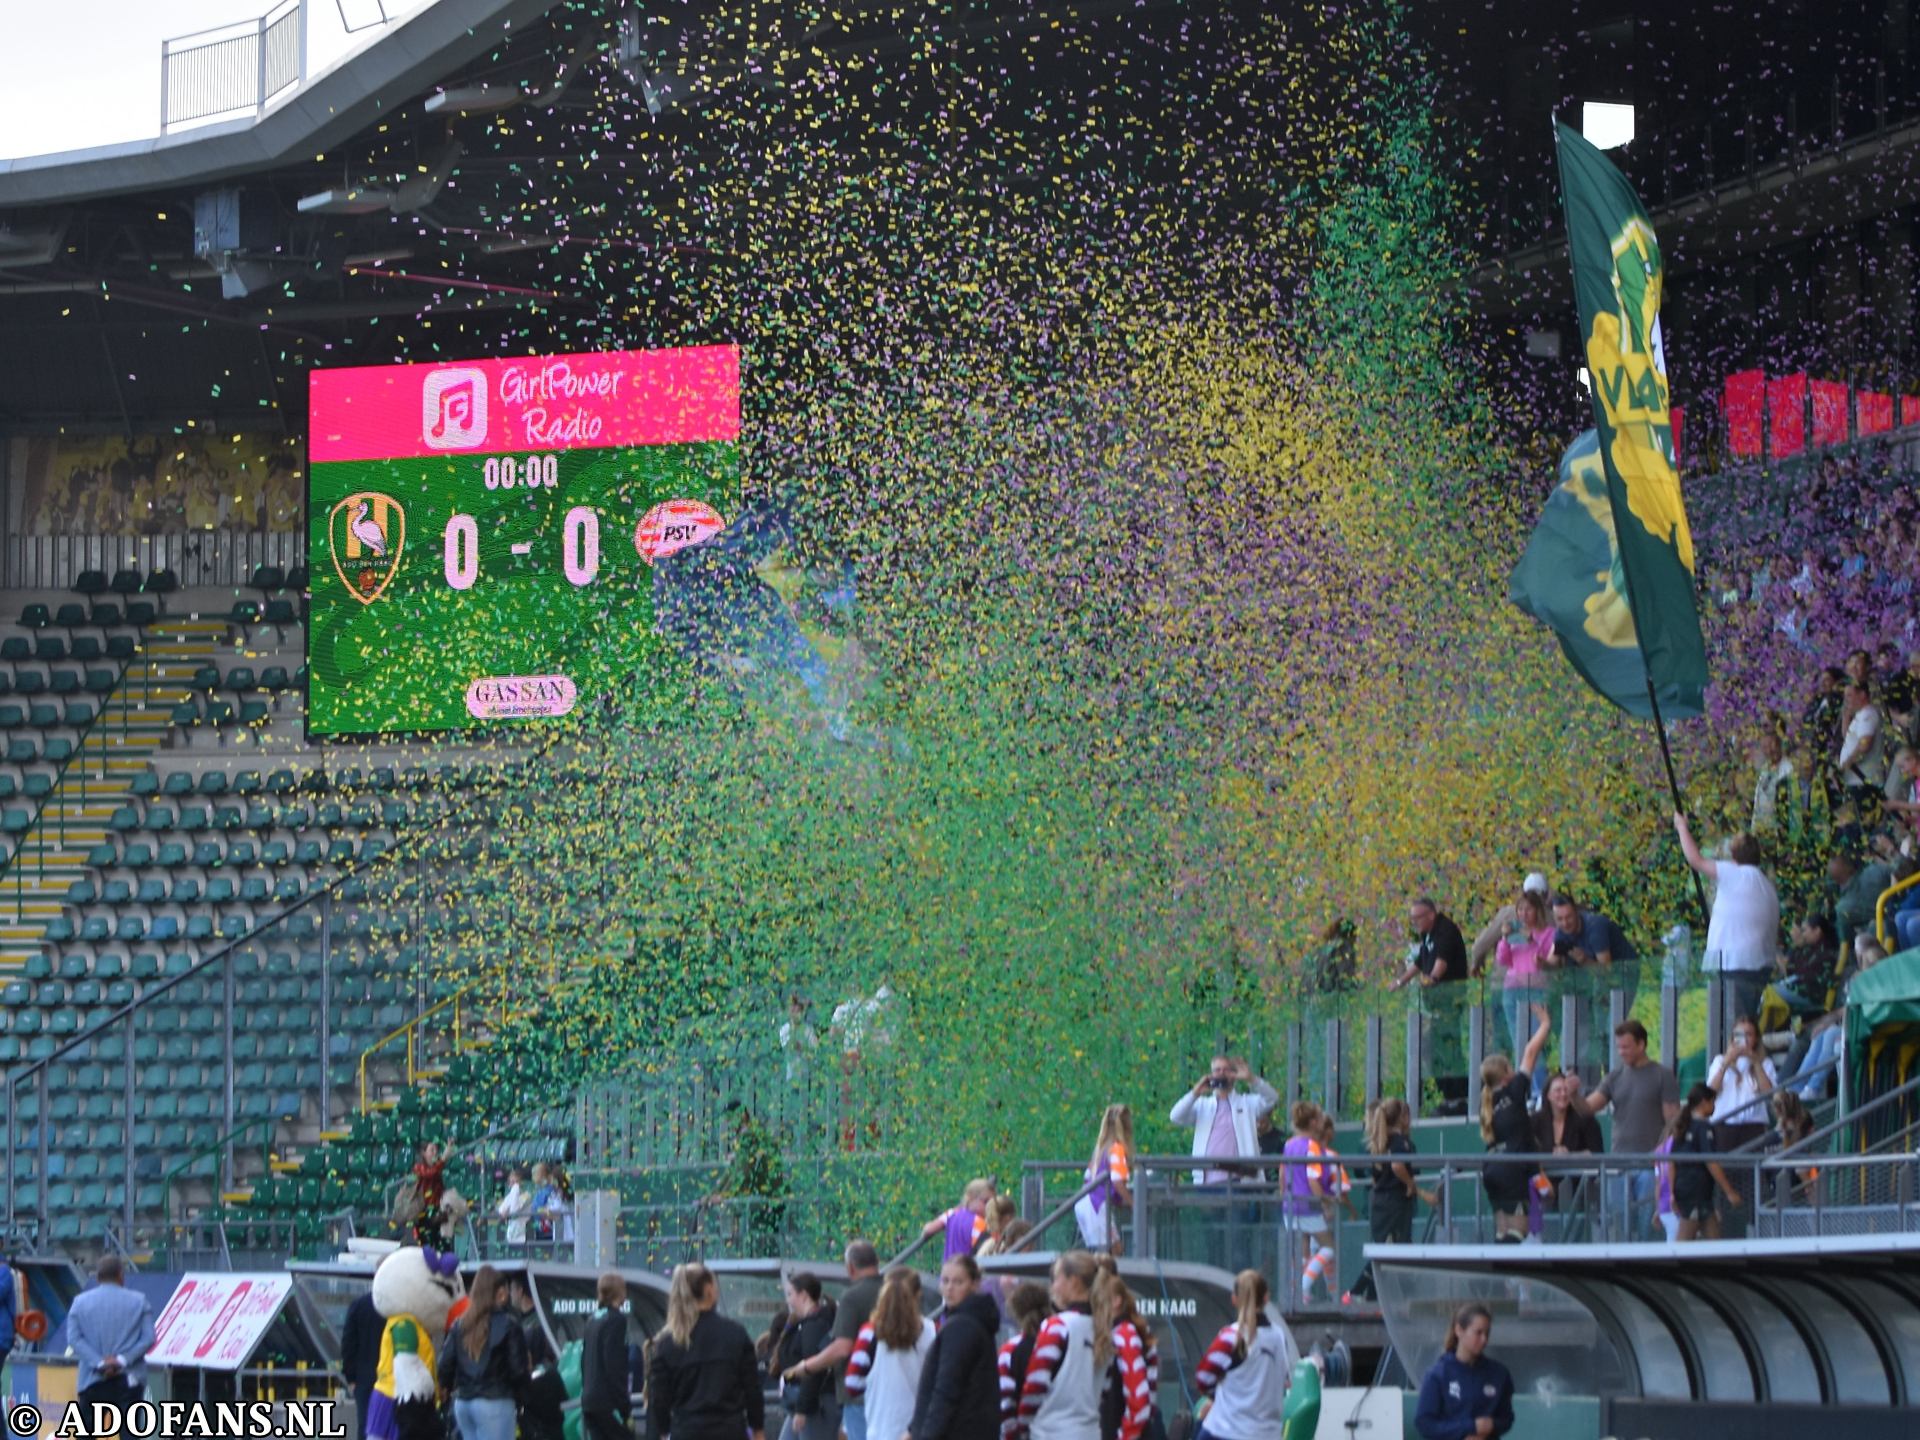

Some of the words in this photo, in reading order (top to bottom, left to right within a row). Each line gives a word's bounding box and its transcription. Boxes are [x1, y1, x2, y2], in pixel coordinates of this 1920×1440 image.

[500, 362, 624, 406] GirlPower
[521, 407, 602, 445] Radio
[484, 454, 558, 490] 00:00
[664, 524, 698, 541] PSV
[444, 513, 479, 590] 0
[563, 505, 600, 587] 0
[475, 680, 564, 703] GASSAN
[553, 1299, 576, 1314] ADO
[579, 1299, 599, 1313] DEN
[1160, 1299, 1196, 1315] HAAG
